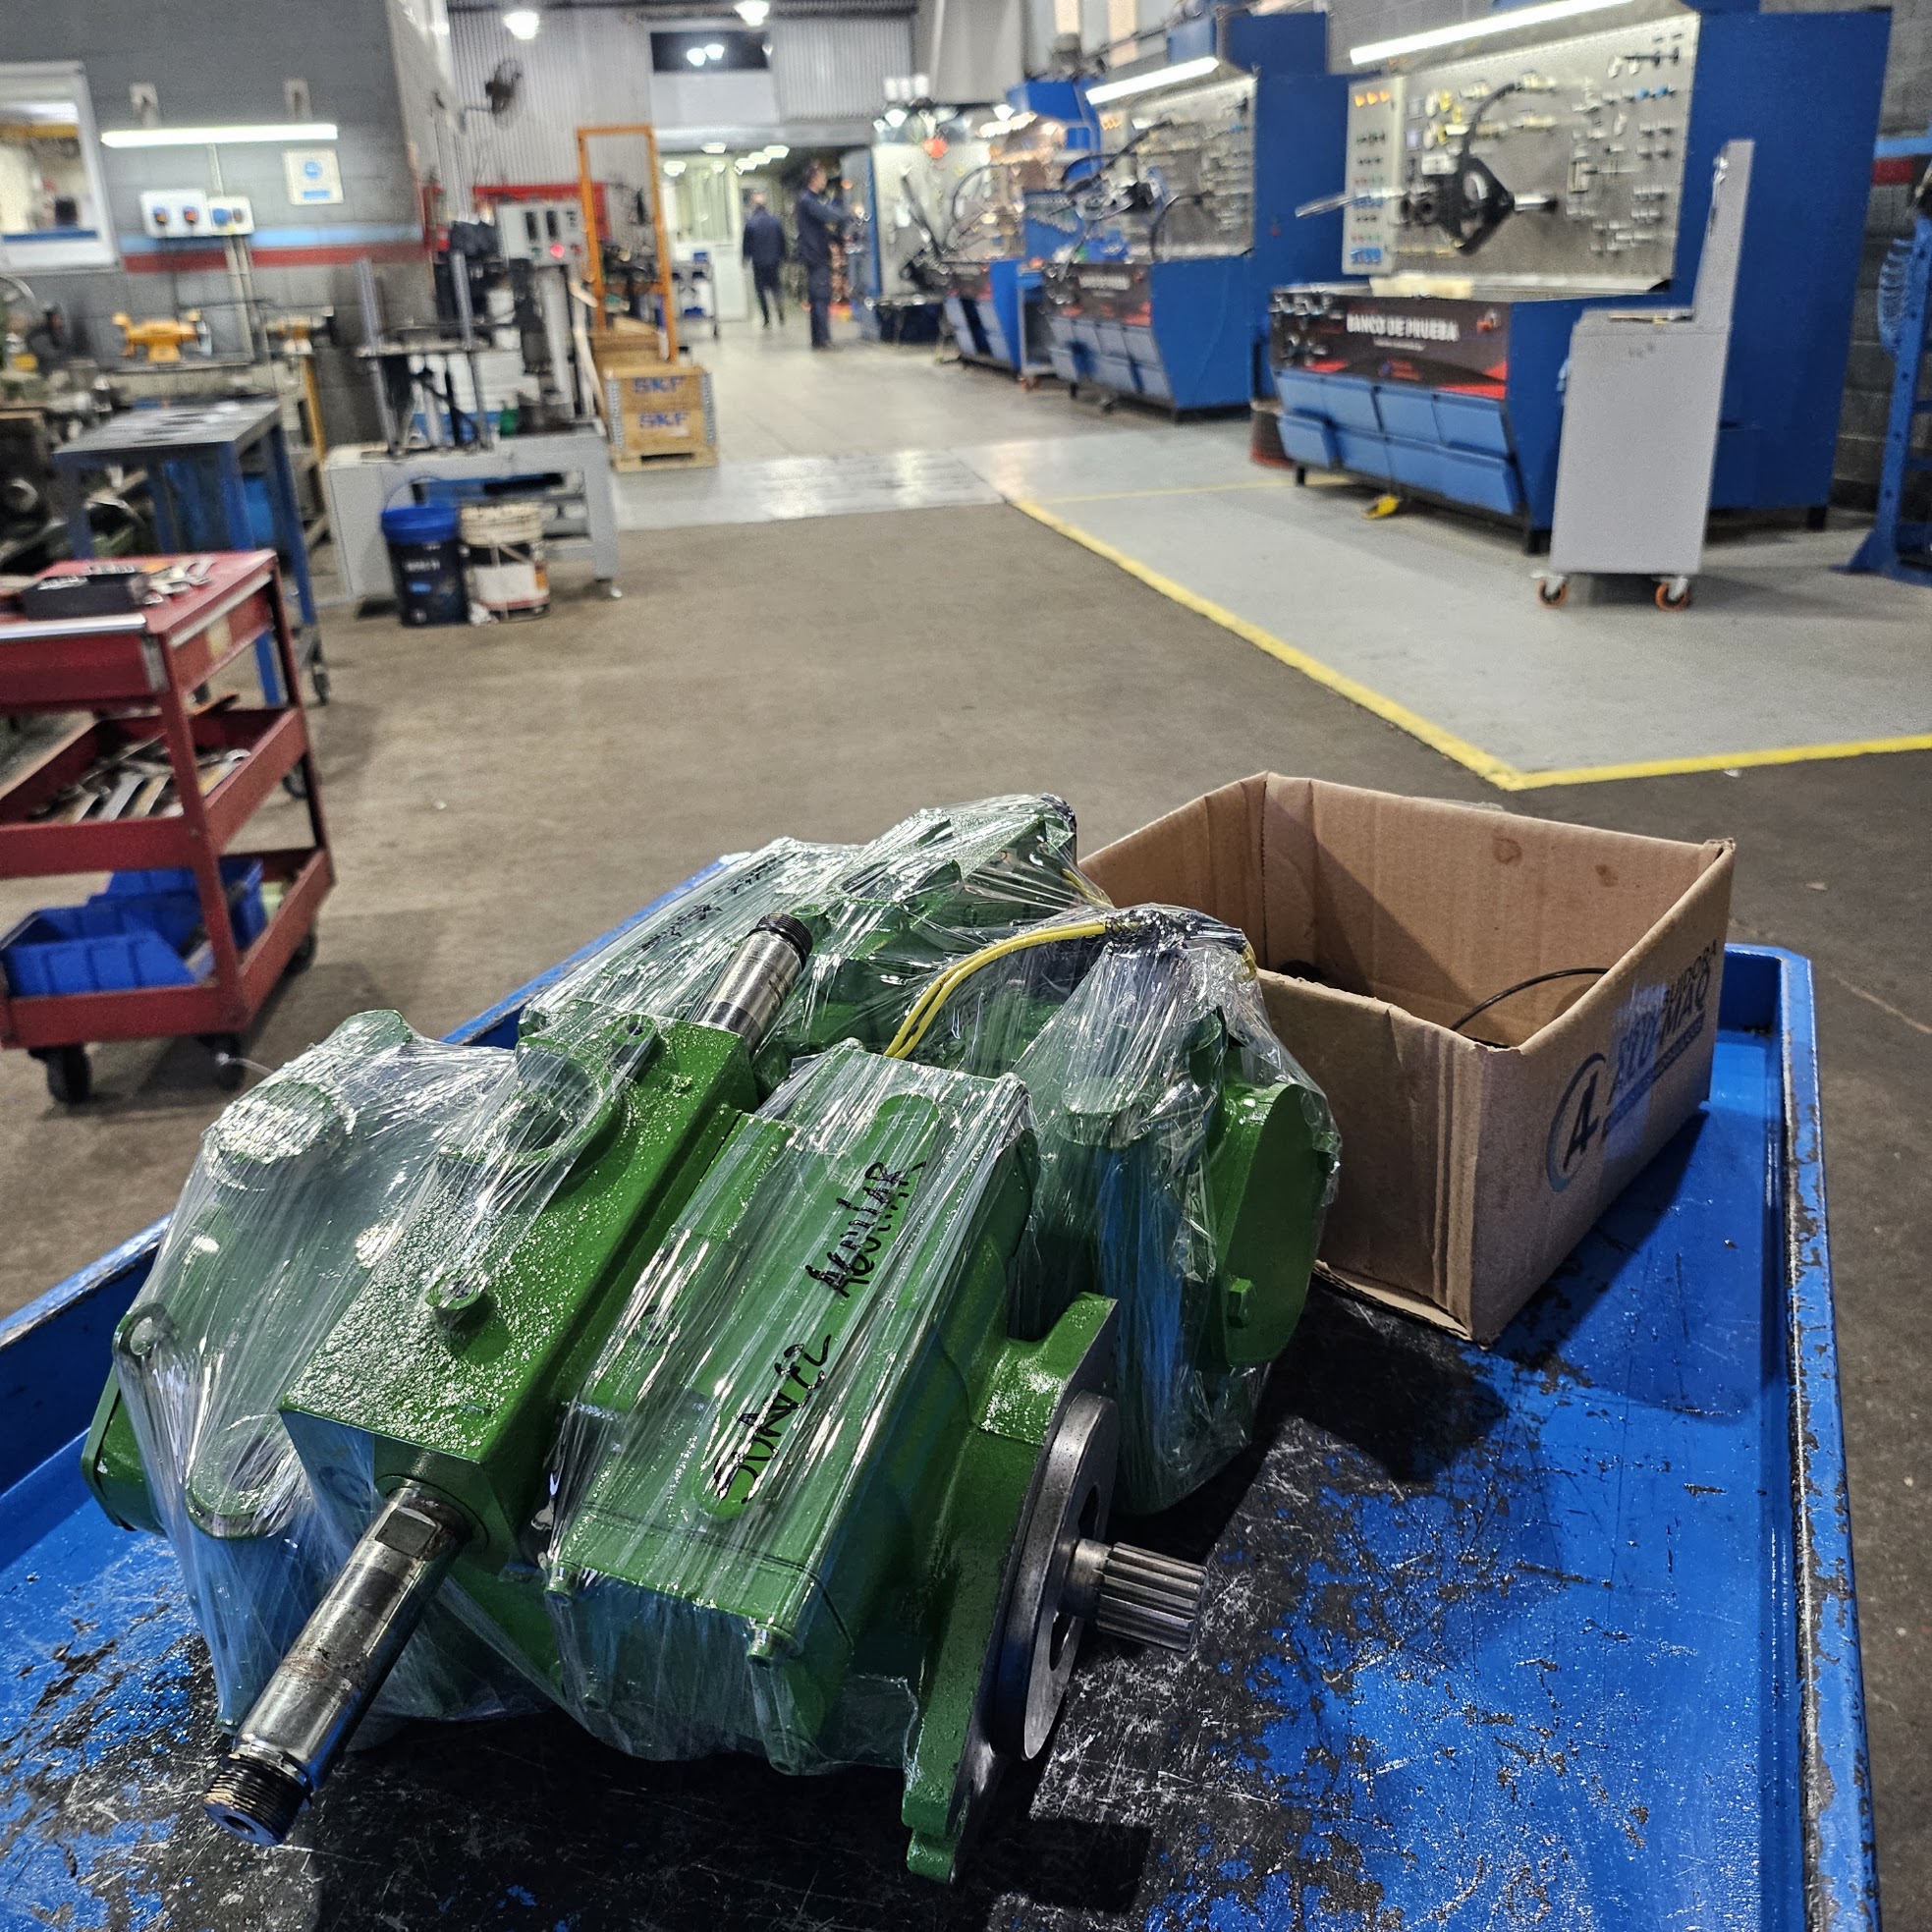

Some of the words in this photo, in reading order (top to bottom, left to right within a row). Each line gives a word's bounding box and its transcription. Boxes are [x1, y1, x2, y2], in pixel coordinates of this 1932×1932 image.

[1347, 313, 1386, 334] BANCO
[1387, 315, 1406, 337] DE
[1406, 316, 1460, 343] PRUEBA
[634, 376, 686, 394] SKF
[639, 412, 690, 428] SKF
